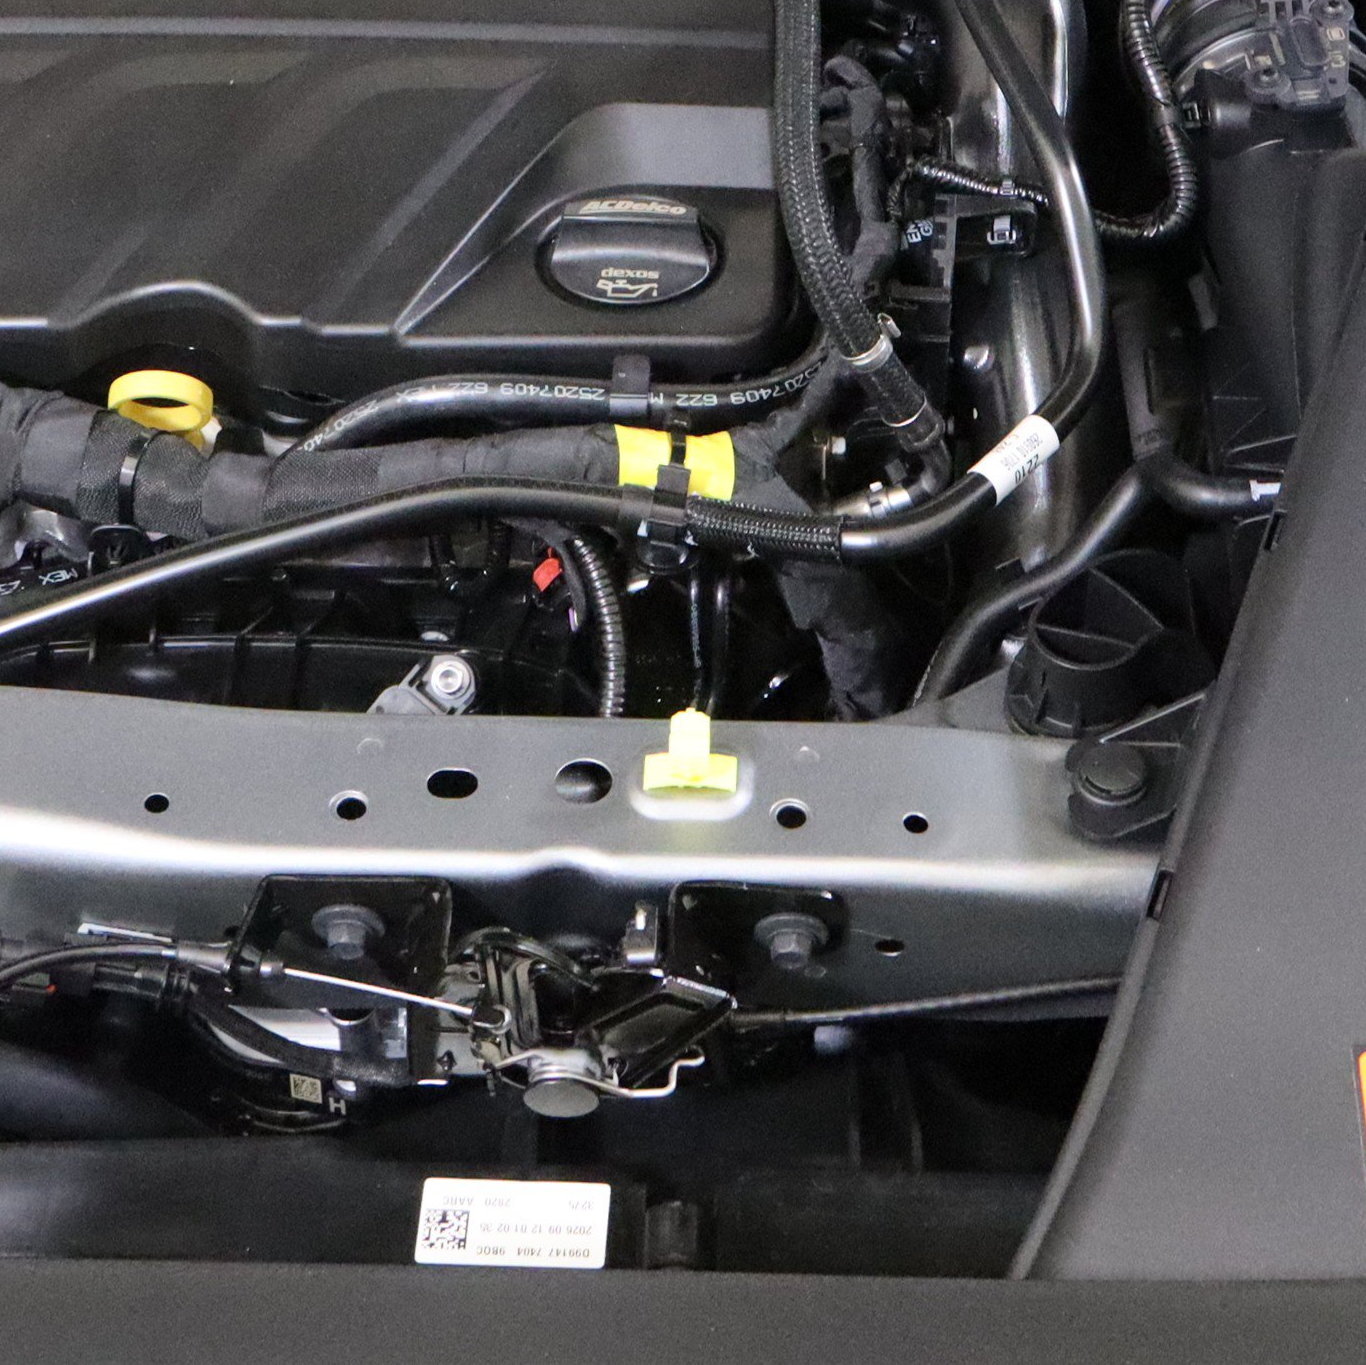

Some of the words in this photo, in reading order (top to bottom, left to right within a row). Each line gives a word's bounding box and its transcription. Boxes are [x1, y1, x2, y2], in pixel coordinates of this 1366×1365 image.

[581, 199, 687, 216] ACDelco
[600, 266, 660, 279] dexos
[499, 382, 605, 401] 25207409
[675, 393, 718, 407] 622
[38, 567, 78, 585] MEX
[328, 1097, 347, 1116] H
